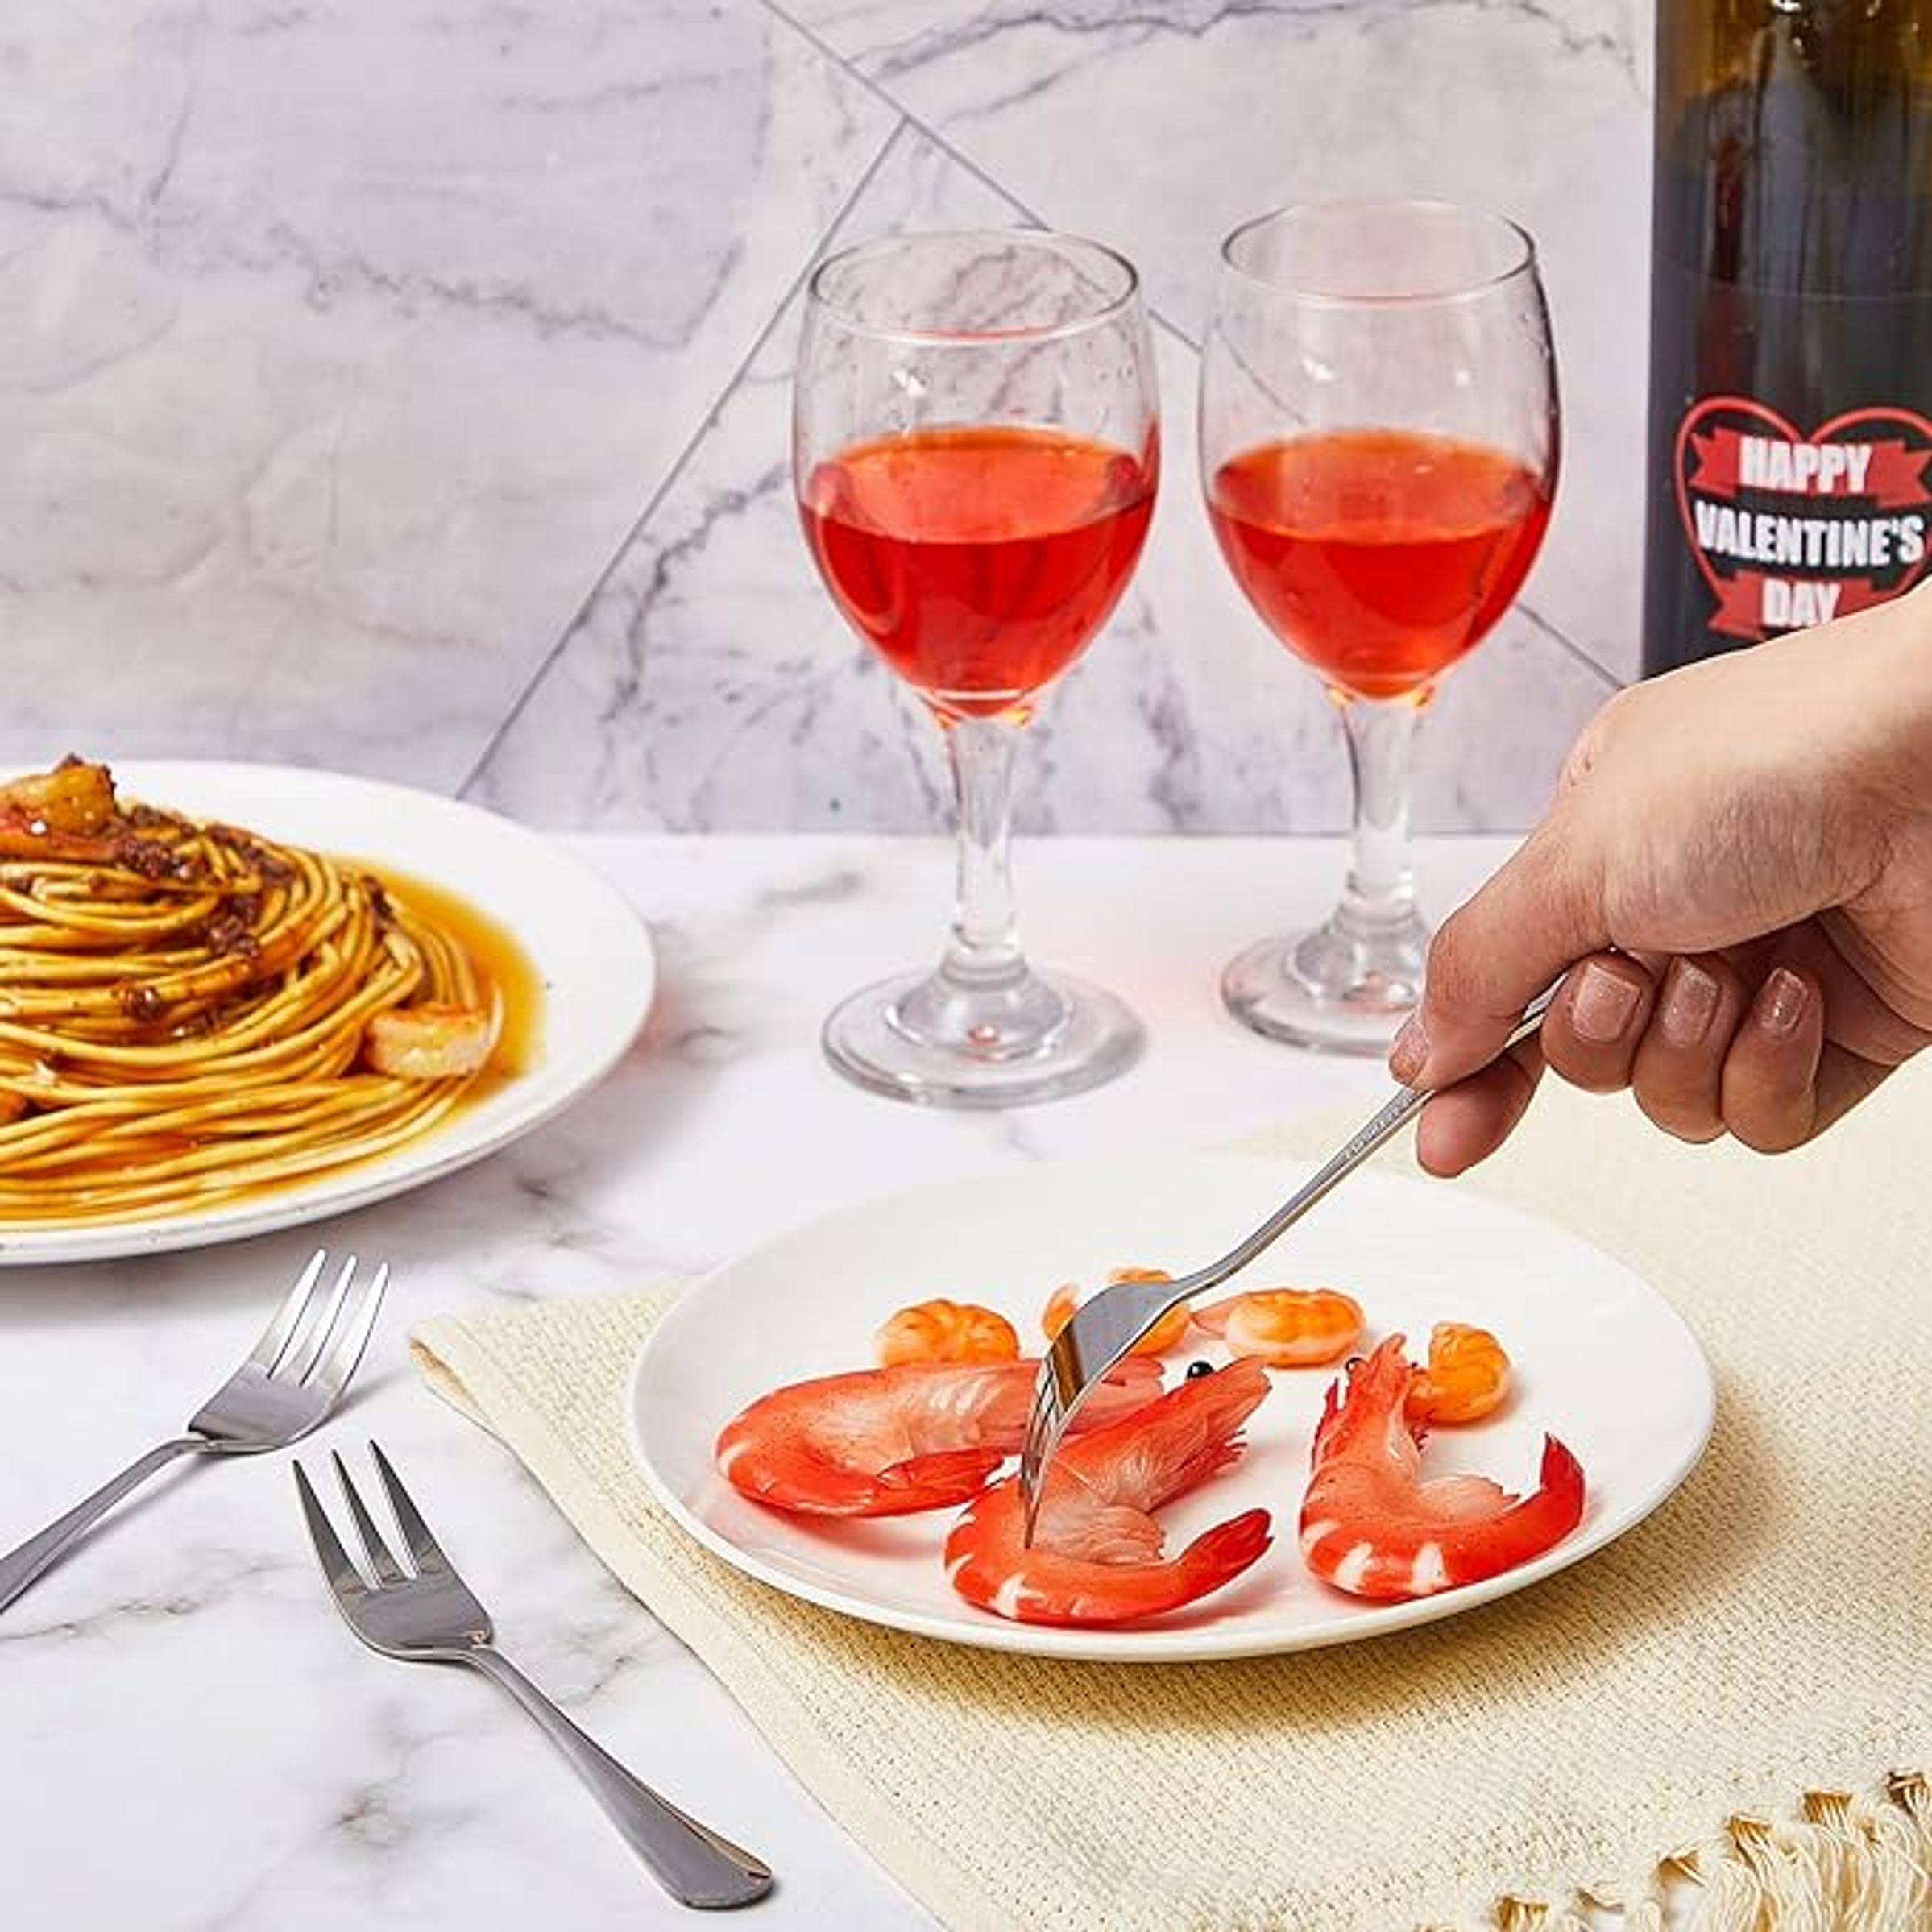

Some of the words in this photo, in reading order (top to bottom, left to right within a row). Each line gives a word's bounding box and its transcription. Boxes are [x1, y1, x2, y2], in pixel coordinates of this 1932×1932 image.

[1739, 436, 1872, 493] HAPPY
[1695, 500, 1925, 567] VALENTINE'S
[1762, 578, 1842, 628] DAY
